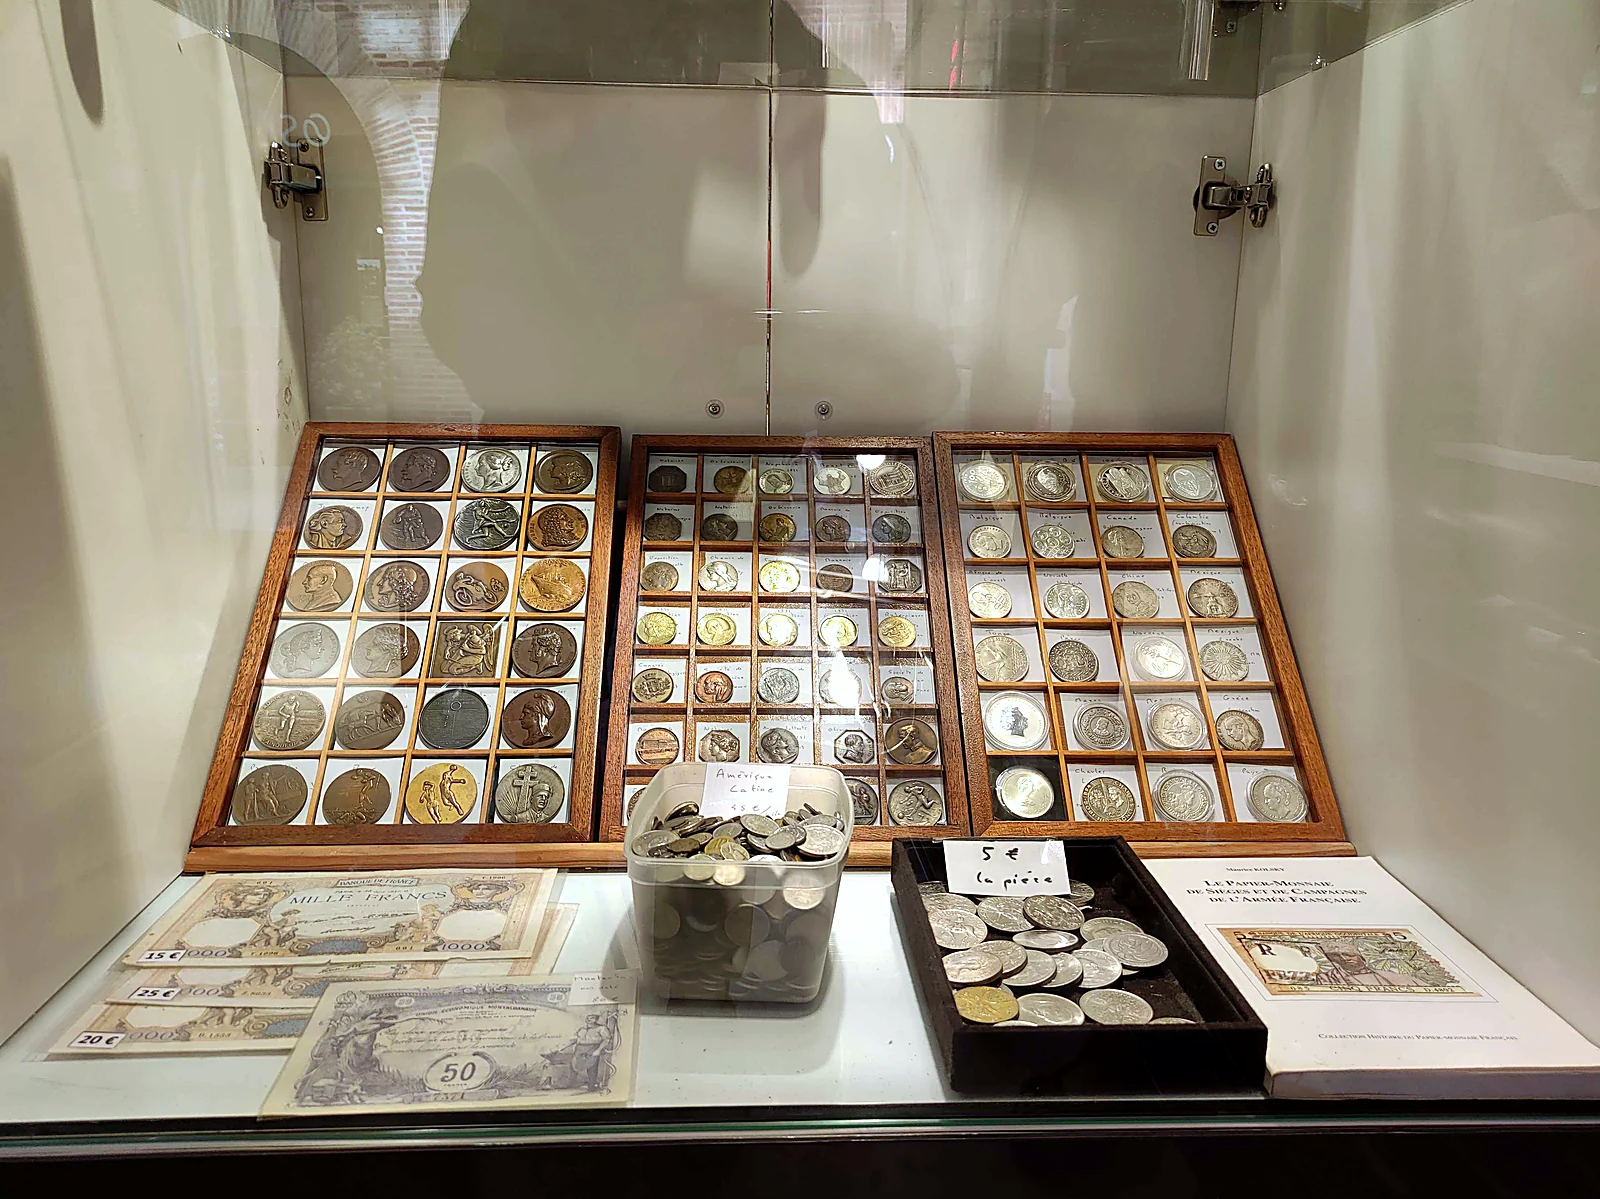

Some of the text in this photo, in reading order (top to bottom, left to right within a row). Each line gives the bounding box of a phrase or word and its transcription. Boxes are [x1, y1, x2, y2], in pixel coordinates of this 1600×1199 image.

[716, 768, 772, 781] Amérique
[729, 784, 774, 793] Latine
[982, 846, 1019, 861] 5 €
[976, 871, 994, 884] la
[290, 893, 354, 904] MILLE
[365, 891, 447, 902] FRANCS
[440, 942, 486, 951] 1000
[145, 951, 181, 960] 15 €
[136, 989, 175, 998] 25 €
[78, 1035, 120, 1045] 20 €
[440, 1062, 476, 1083] 50
